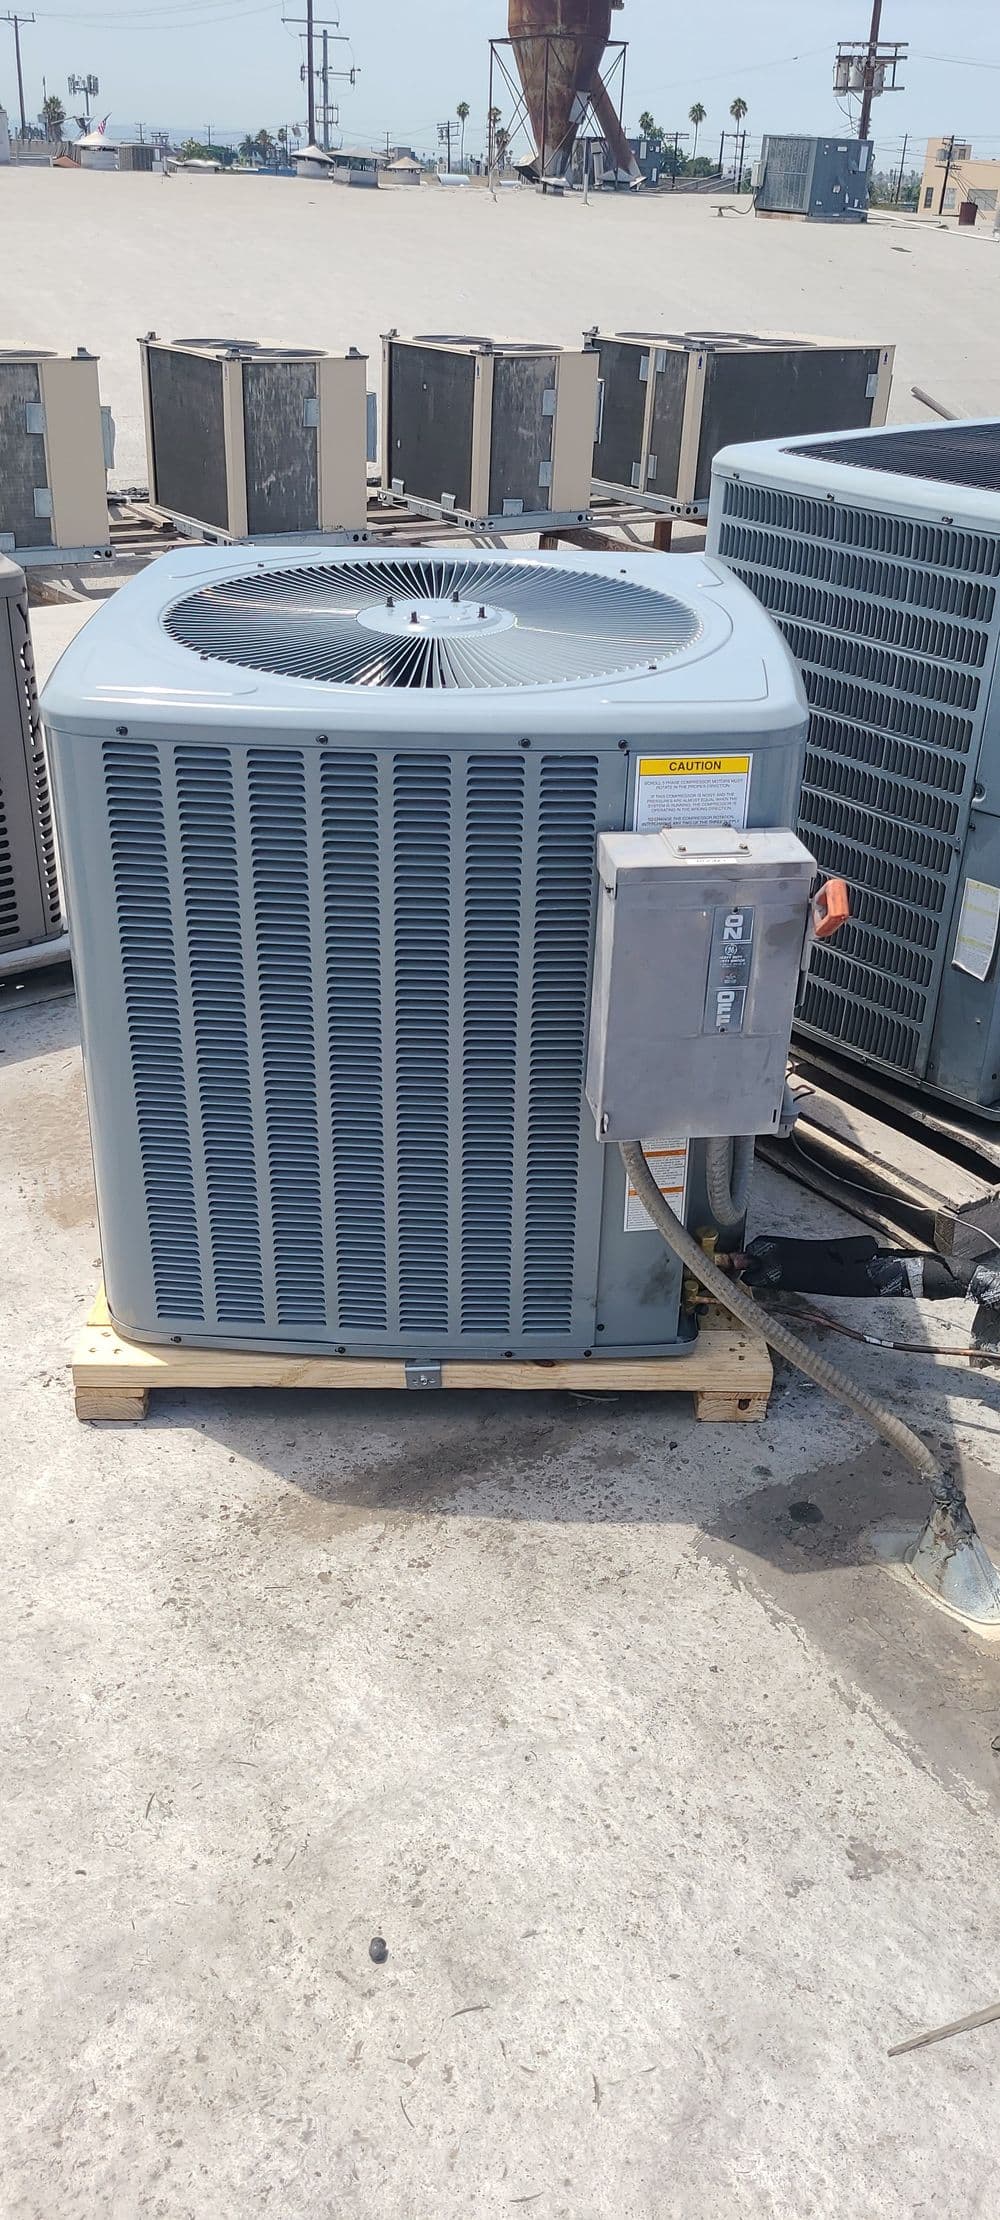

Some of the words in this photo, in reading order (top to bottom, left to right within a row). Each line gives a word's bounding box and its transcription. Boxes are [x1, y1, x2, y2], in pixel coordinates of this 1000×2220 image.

[669, 761, 721, 771] CAUTION
[723, 914, 743, 939] ON
[716, 991, 735, 1026] OFF
